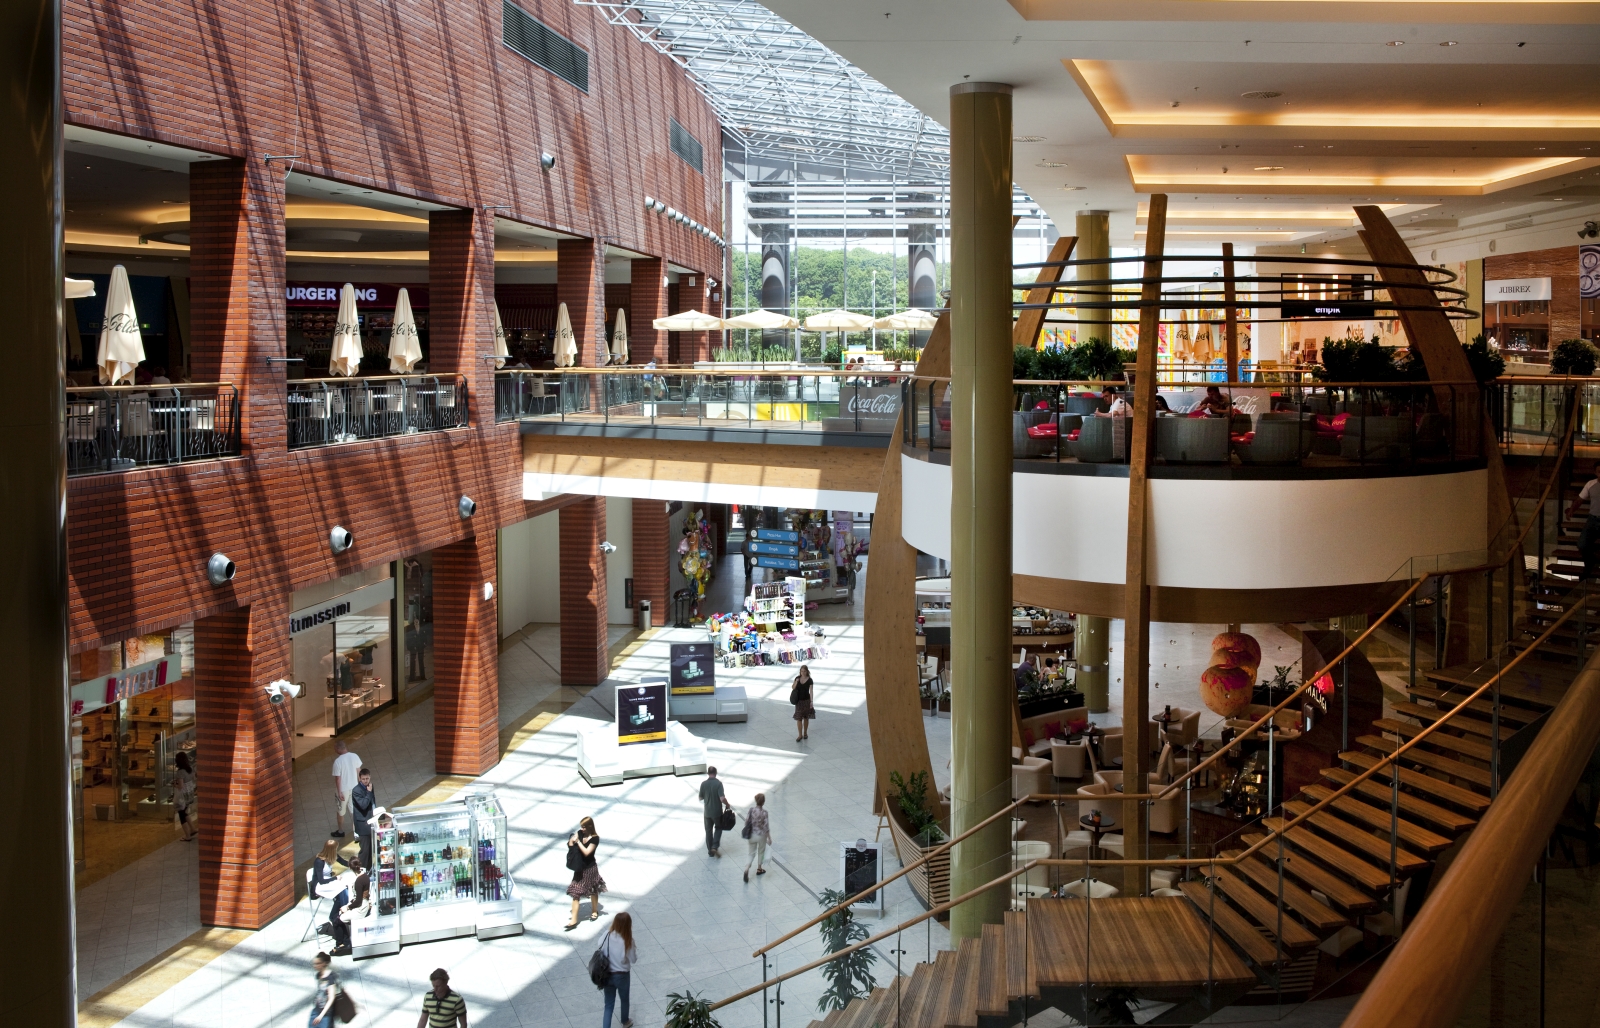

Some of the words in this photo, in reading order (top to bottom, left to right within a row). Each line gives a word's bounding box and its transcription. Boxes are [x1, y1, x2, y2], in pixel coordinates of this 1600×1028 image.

[286, 287, 336, 300] URGER
[340, 287, 377, 301] NG
[1498, 285, 1532, 294] JUBIREX
[847, 393, 899, 414] Coca-Cola
[290, 602, 350, 633] timissimi
